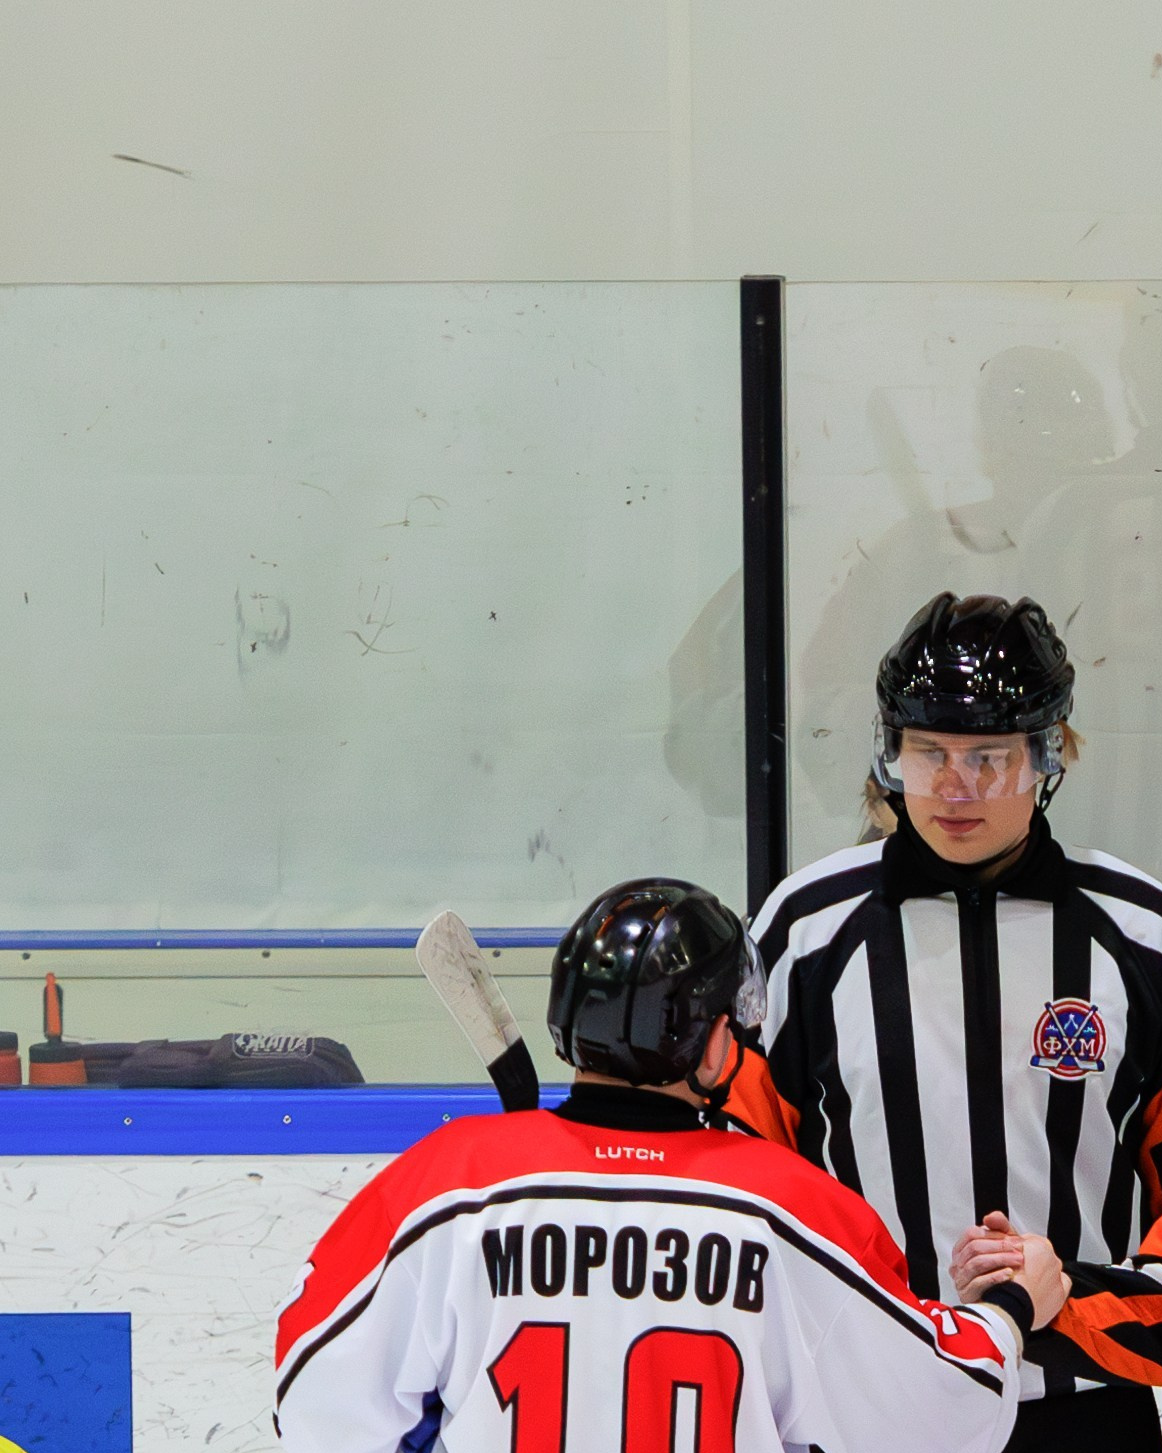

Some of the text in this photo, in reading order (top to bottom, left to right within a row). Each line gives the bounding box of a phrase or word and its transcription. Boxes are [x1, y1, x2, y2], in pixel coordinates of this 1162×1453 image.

[1043, 1036, 1096, 1058] ФХМ
[595, 1146, 665, 1162] LUTCH
[481, 1223, 769, 1314] МОРОЗОВ
